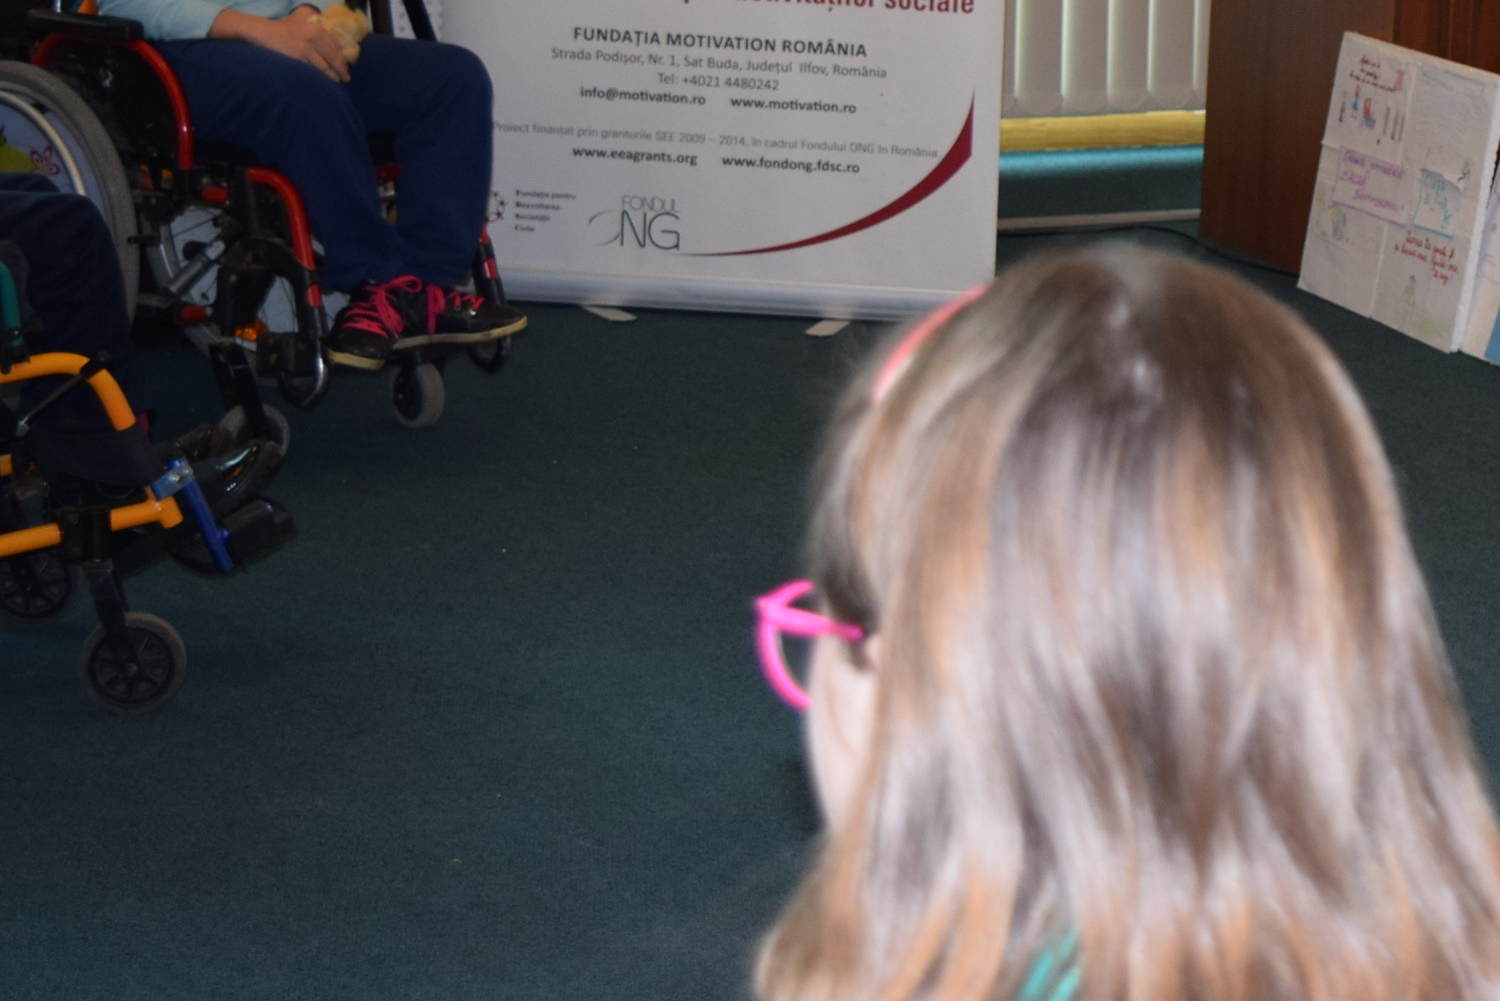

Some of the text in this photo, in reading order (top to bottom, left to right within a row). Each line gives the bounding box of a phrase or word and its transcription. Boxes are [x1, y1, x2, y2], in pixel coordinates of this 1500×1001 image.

[573, 27, 867, 58] FUNDAȚIA MOTIVATION ROMÂNIA
[551, 47, 592, 61] Strada
[648, 53, 665, 65] Nr.
[670, 55, 680, 68] 1,
[683, 56, 703, 68] Sat
[707, 57, 742, 71] Buda,
[799, 61, 829, 76] Ilfov,
[833, 64, 887, 79] România
[658, 72, 780, 91] Tel: +4021 4480242
[580, 86, 857, 114] info@motivation.ro www.motivation.ro
[577, 127, 598, 138] prin
[600, 127, 652, 141] granturile
[655, 130, 676, 142] SEE
[679, 132, 706, 143] 2009
[751, 136, 762, 148] în
[764, 137, 798, 149] cadrul
[801, 139, 847, 151] Fondului
[849, 141, 875, 154] ONG
[891, 145, 938, 158] România
[572, 147, 861, 174] www.eeagrants.org www.fondong.fdsc.ro
[621, 194, 680, 212] FONDUL
